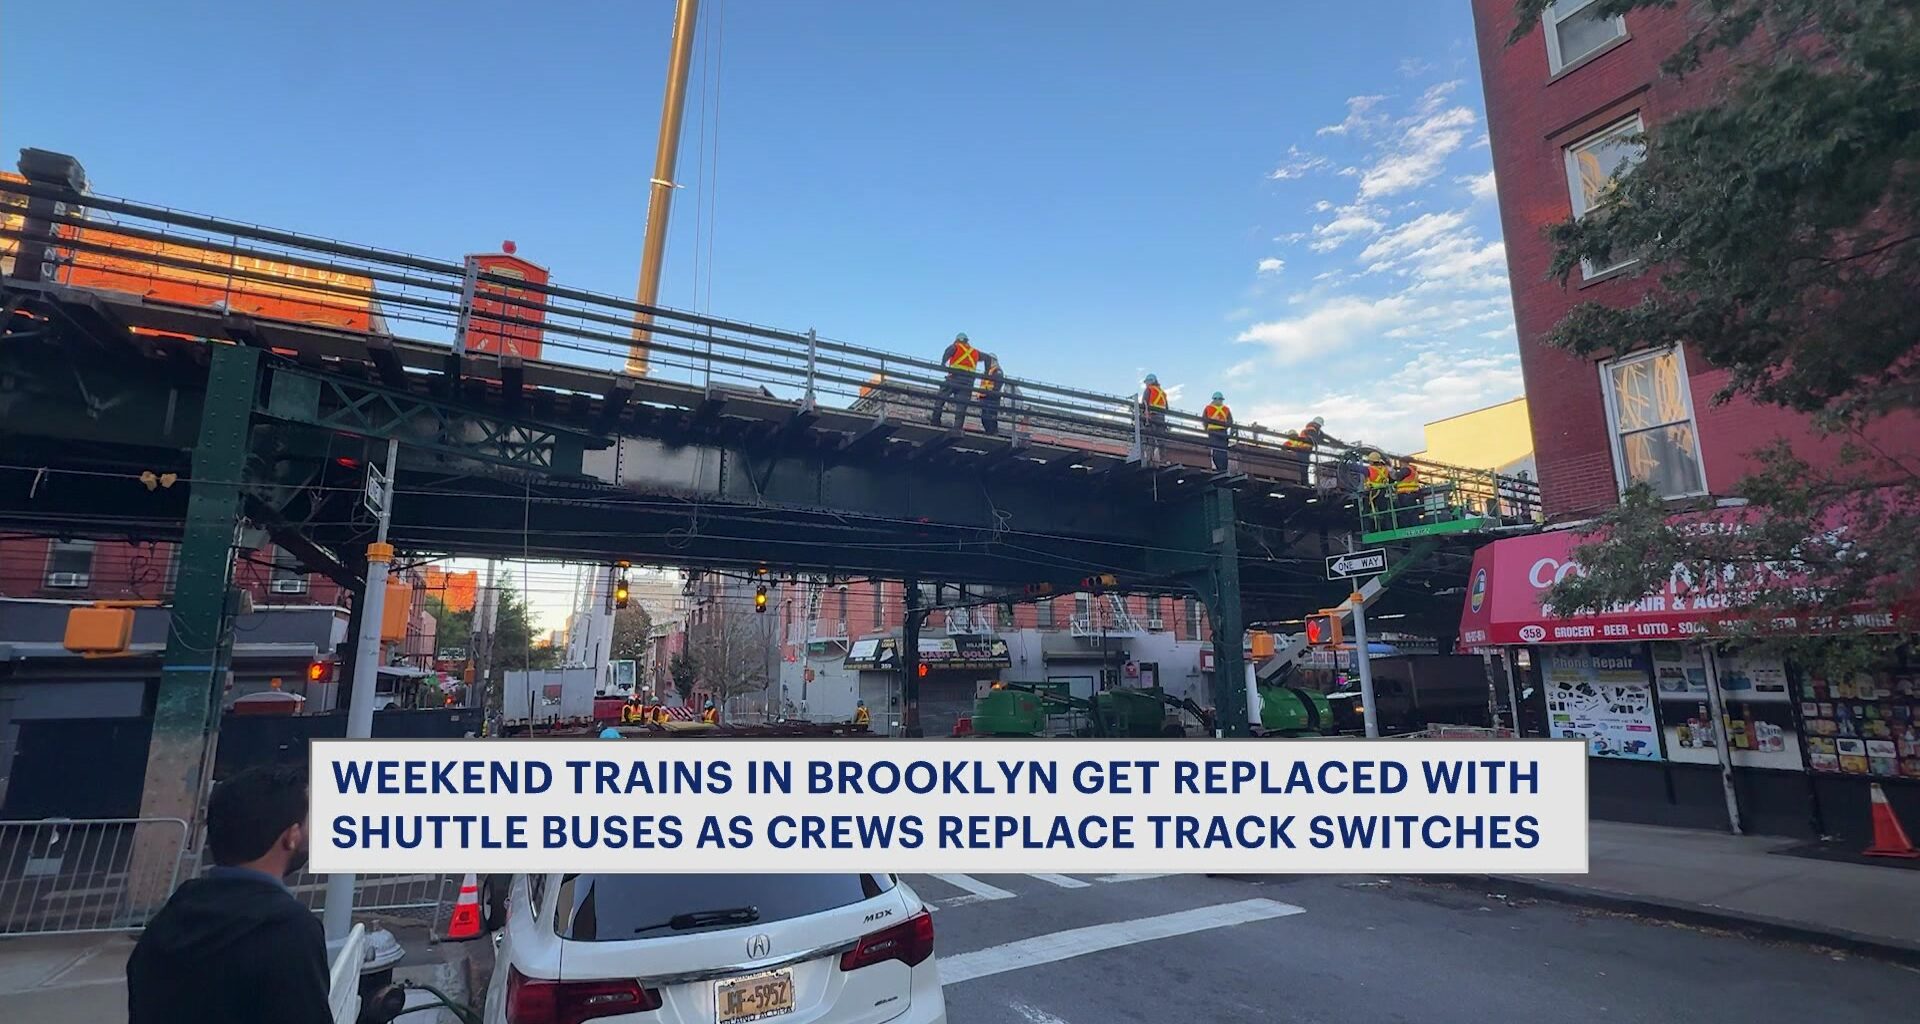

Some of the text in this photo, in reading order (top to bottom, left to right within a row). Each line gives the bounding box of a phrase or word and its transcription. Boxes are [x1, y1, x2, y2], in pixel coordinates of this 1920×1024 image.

[1338, 557, 1379, 571] ONE WAY
[1554, 625, 1595, 638] GROCERY
[1603, 624, 1629, 636] BEER
[1637, 622, 1669, 635] LOTTO
[1852, 613, 1894, 628] MORE
[1523, 628, 1542, 639] 358
[919, 651, 950, 659] CASH
[962, 650, 991, 658] GOLD
[1552, 655, 1633, 670] Phone Repair
[863, 908, 893, 924] MDX
[759, 1006, 793, 1020] ACURA
